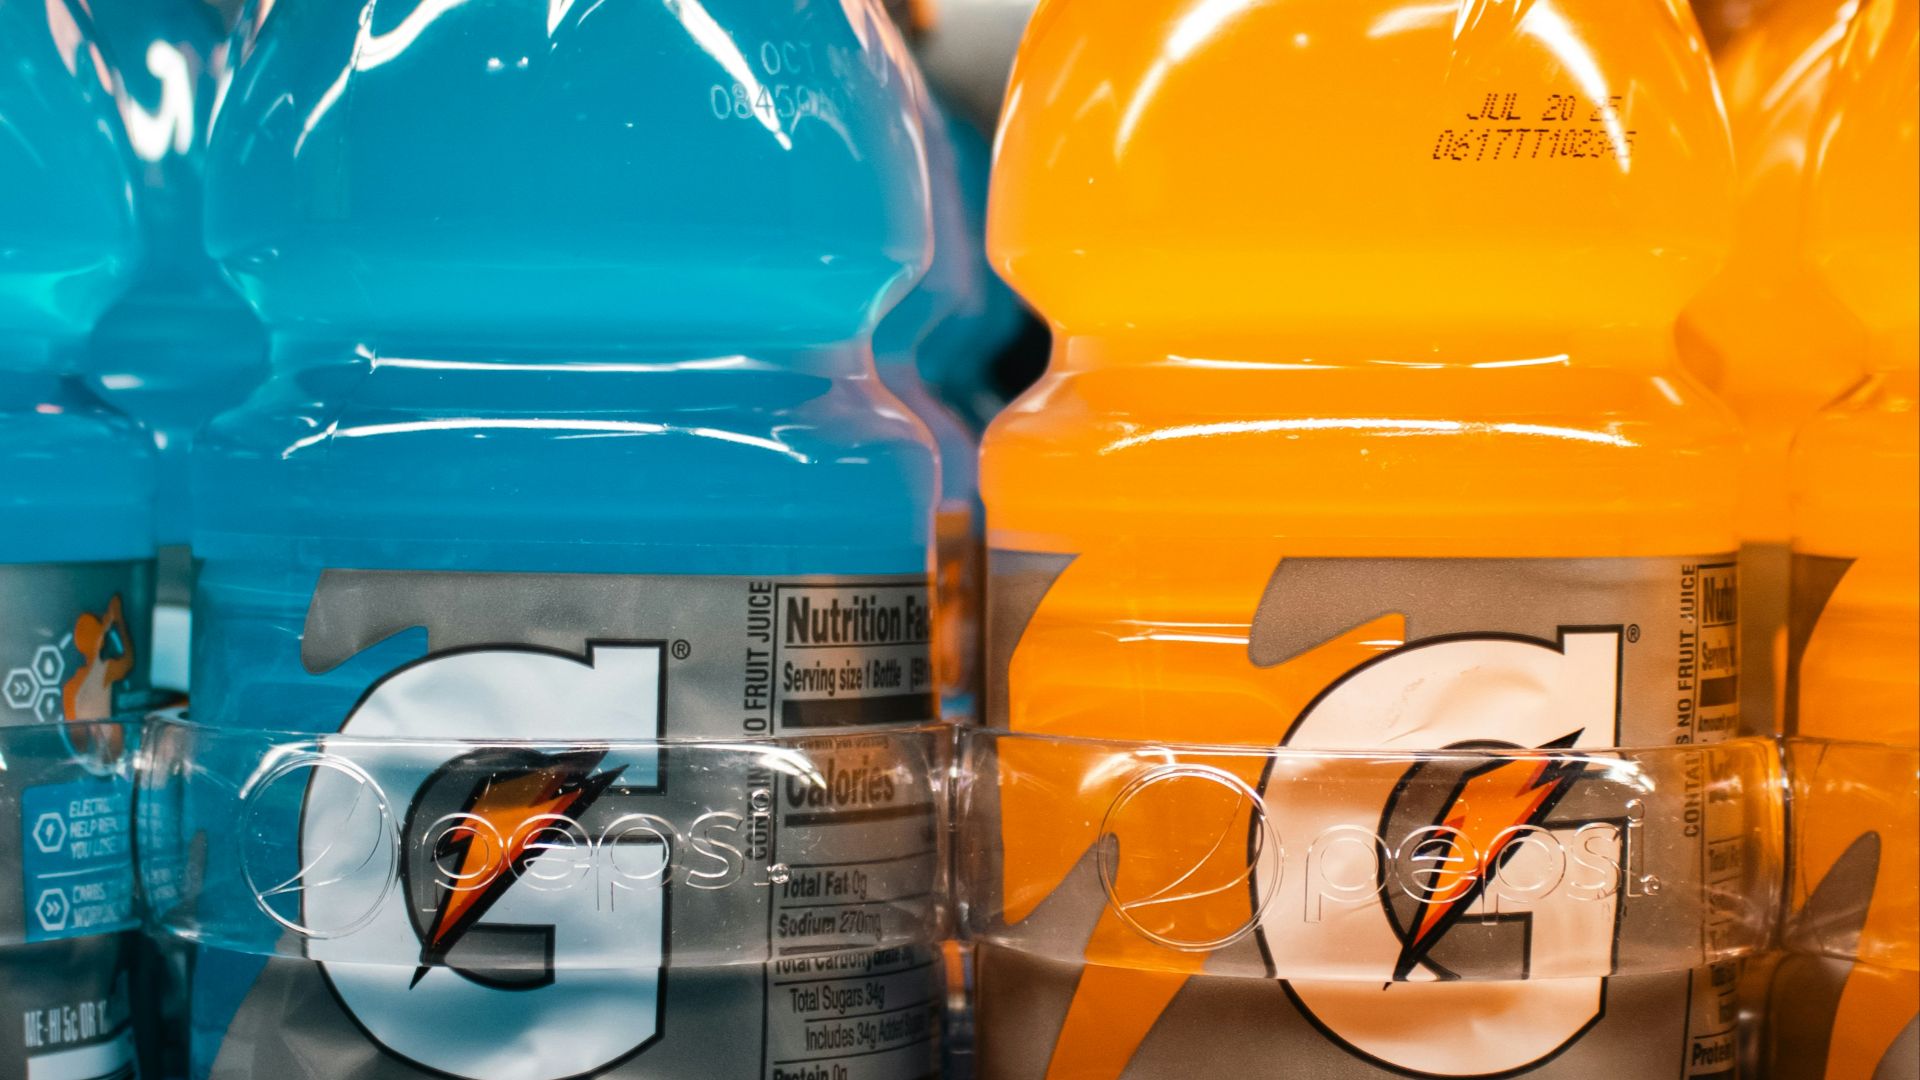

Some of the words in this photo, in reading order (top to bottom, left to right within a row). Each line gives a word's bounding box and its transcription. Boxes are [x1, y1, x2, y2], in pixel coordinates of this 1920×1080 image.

[1466, 92, 1521, 121] JUL
[1541, 94, 1577, 121] 20
[747, 581, 773, 643] JUICE
[785, 595, 901, 645] Nutrition
[1680, 564, 1696, 624] JUICE
[744, 647, 770, 711] FRUIT
[784, 660, 836, 697] Serving
[840, 659, 863, 691] size
[873, 658, 901, 688] Bottle
[1677, 629, 1695, 692] FRUIT
[1677, 698, 1693, 728] NO
[785, 755, 896, 809] Calories
[298, 638, 673, 1080] G
[422, 788, 772, 913] pepsi
[1246, 623, 1629, 1080] G
[1304, 798, 1648, 925] pepsi
[783, 872, 820, 899] Total
[825, 871, 848, 895] Fat
[852, 870, 868, 899] 0g
[778, 911, 836, 938] Sodium
[840, 910, 883, 942] 270mg
[24, 1007, 61, 1048] ME-HI
[80, 1001, 96, 1038] OR
[789, 986, 820, 1014] Total
[822, 984, 864, 1016] Sugars
[866, 981, 886, 1011] 34g
[806, 1022, 855, 1052] Includes
[857, 1021, 877, 1050] 34g
